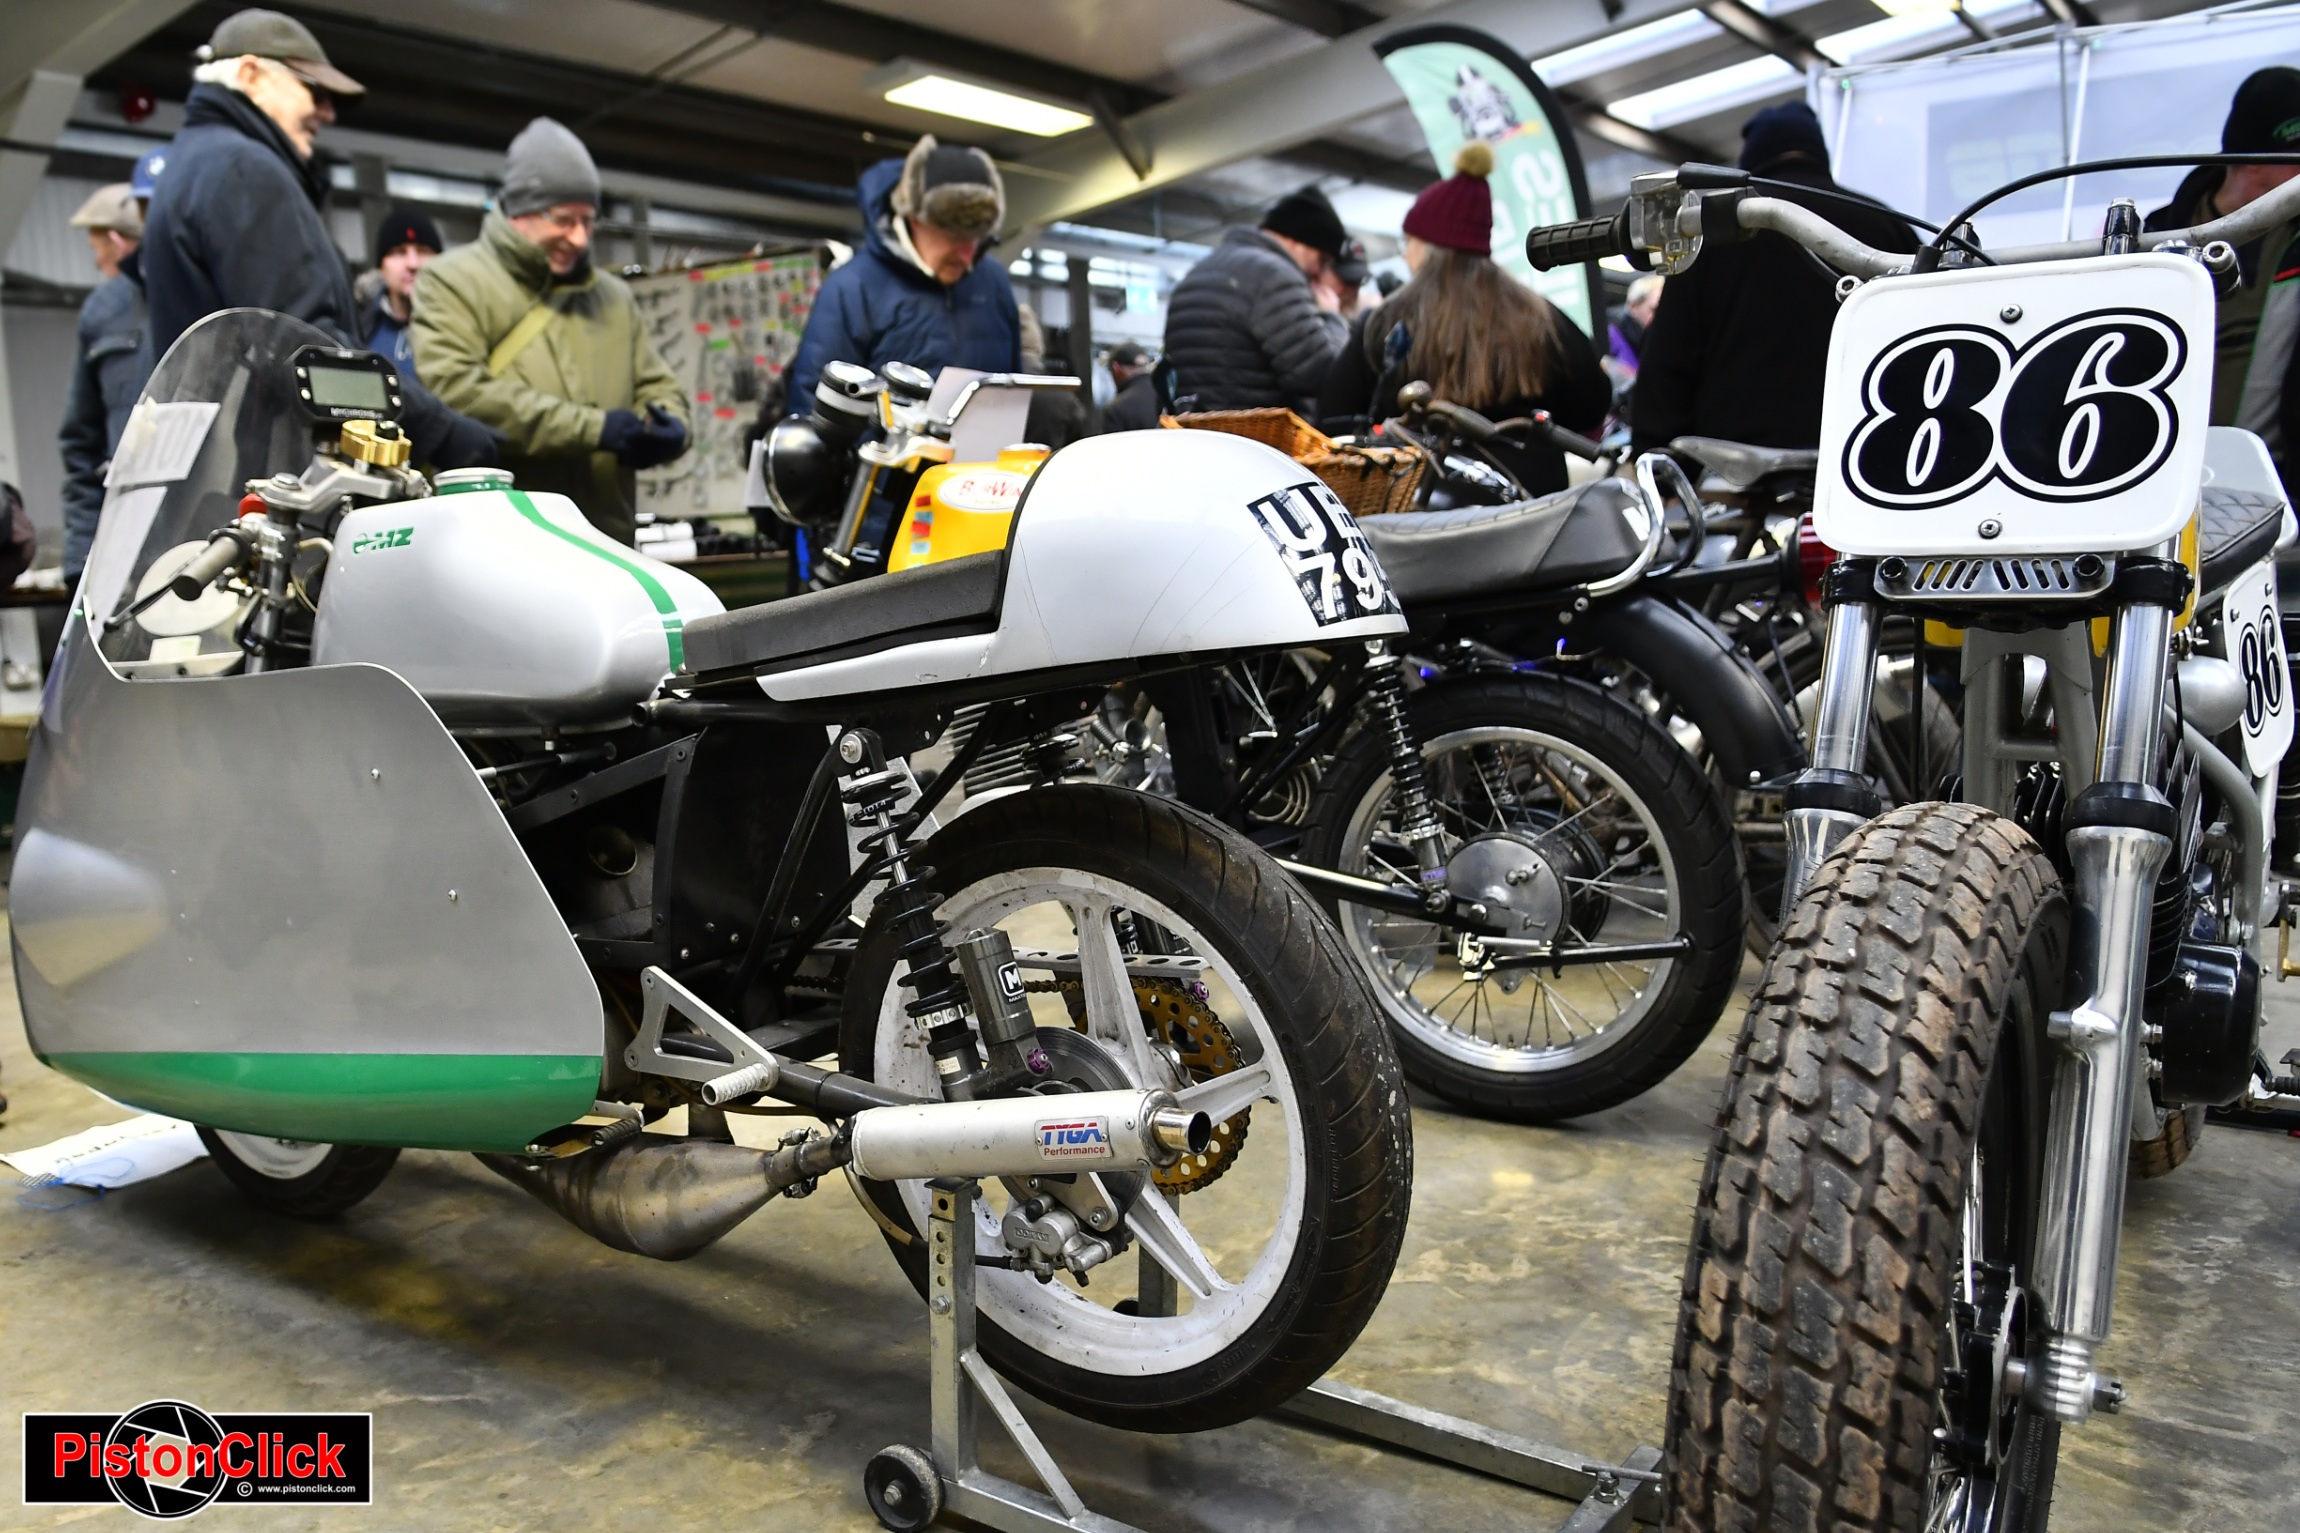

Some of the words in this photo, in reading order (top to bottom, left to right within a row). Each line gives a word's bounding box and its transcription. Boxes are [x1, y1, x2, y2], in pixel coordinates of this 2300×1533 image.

[1841, 307, 2188, 511] 86
[2239, 604, 2285, 739] 86
[1041, 1122, 1103, 1146] TYGA
[1044, 1146, 1106, 1156] Performance
